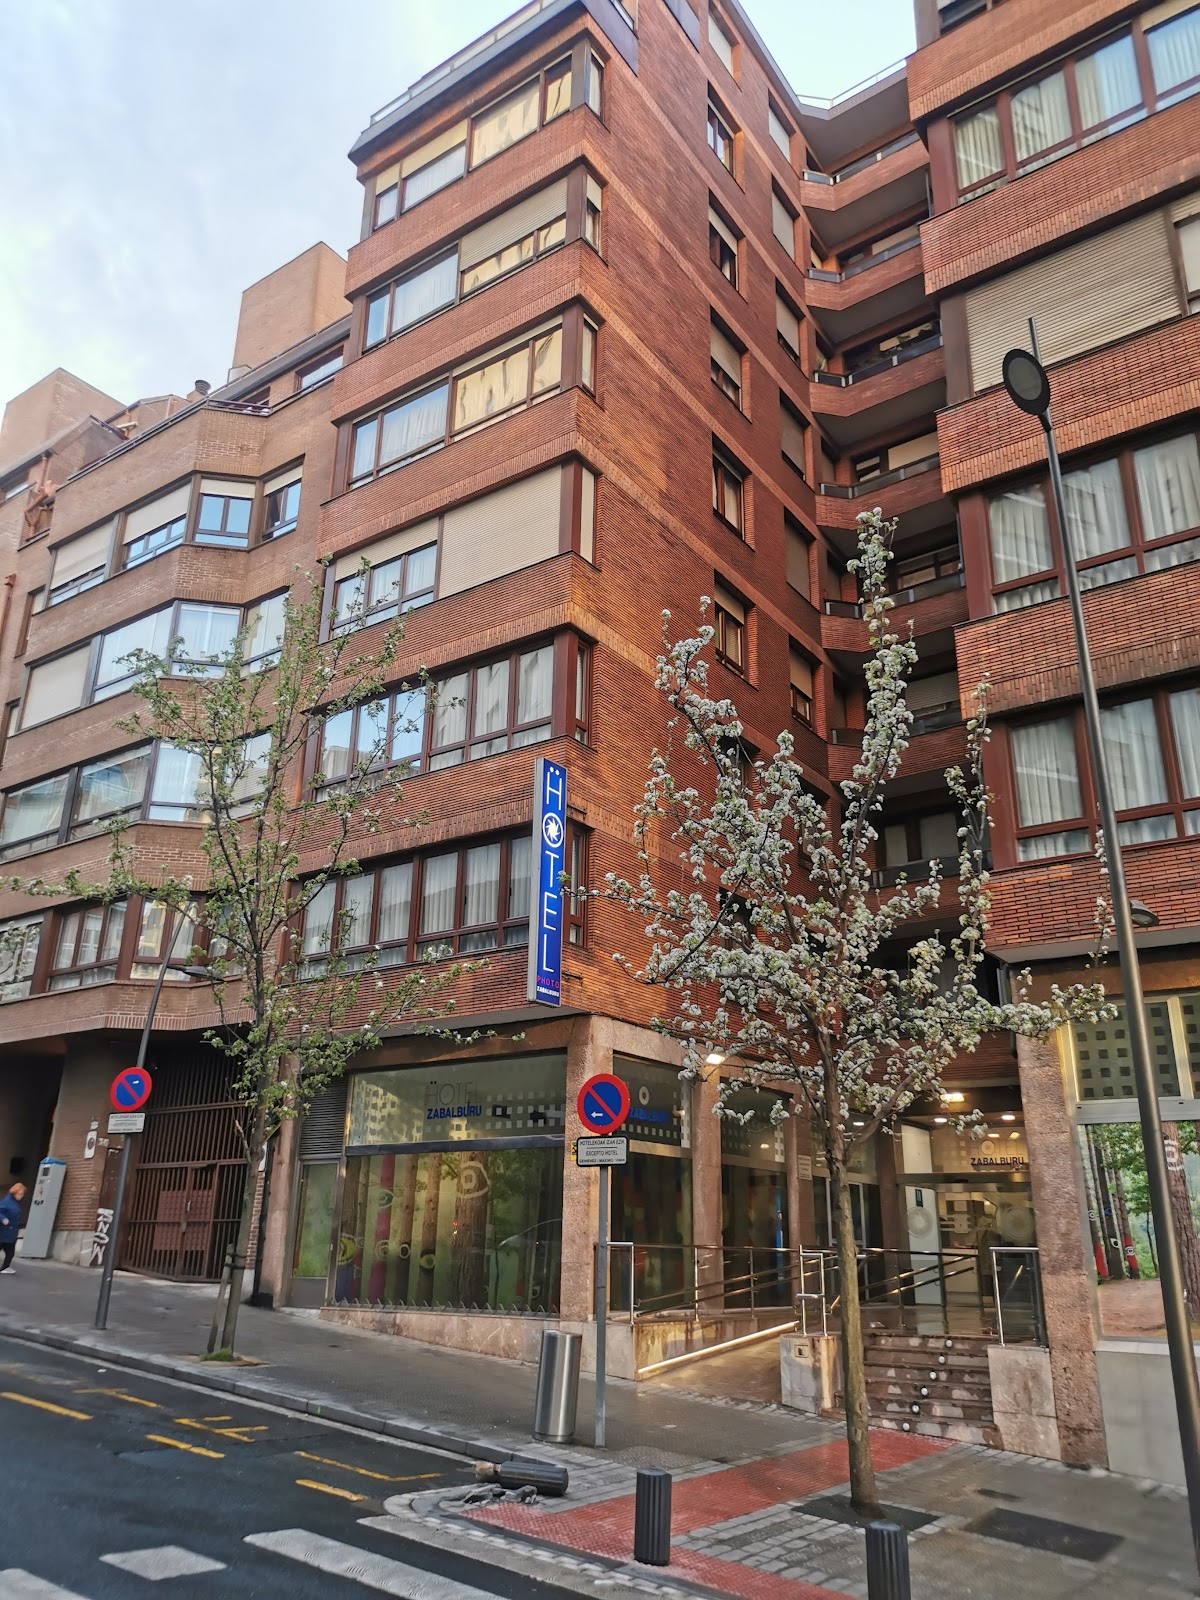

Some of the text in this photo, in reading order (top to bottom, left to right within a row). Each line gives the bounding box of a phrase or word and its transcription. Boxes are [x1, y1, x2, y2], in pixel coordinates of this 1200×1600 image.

[536, 975, 560, 989] PHOTO
[427, 1105, 482, 1119] ZABALBURU
[971, 1156, 1025, 1166] ZABALBURU
